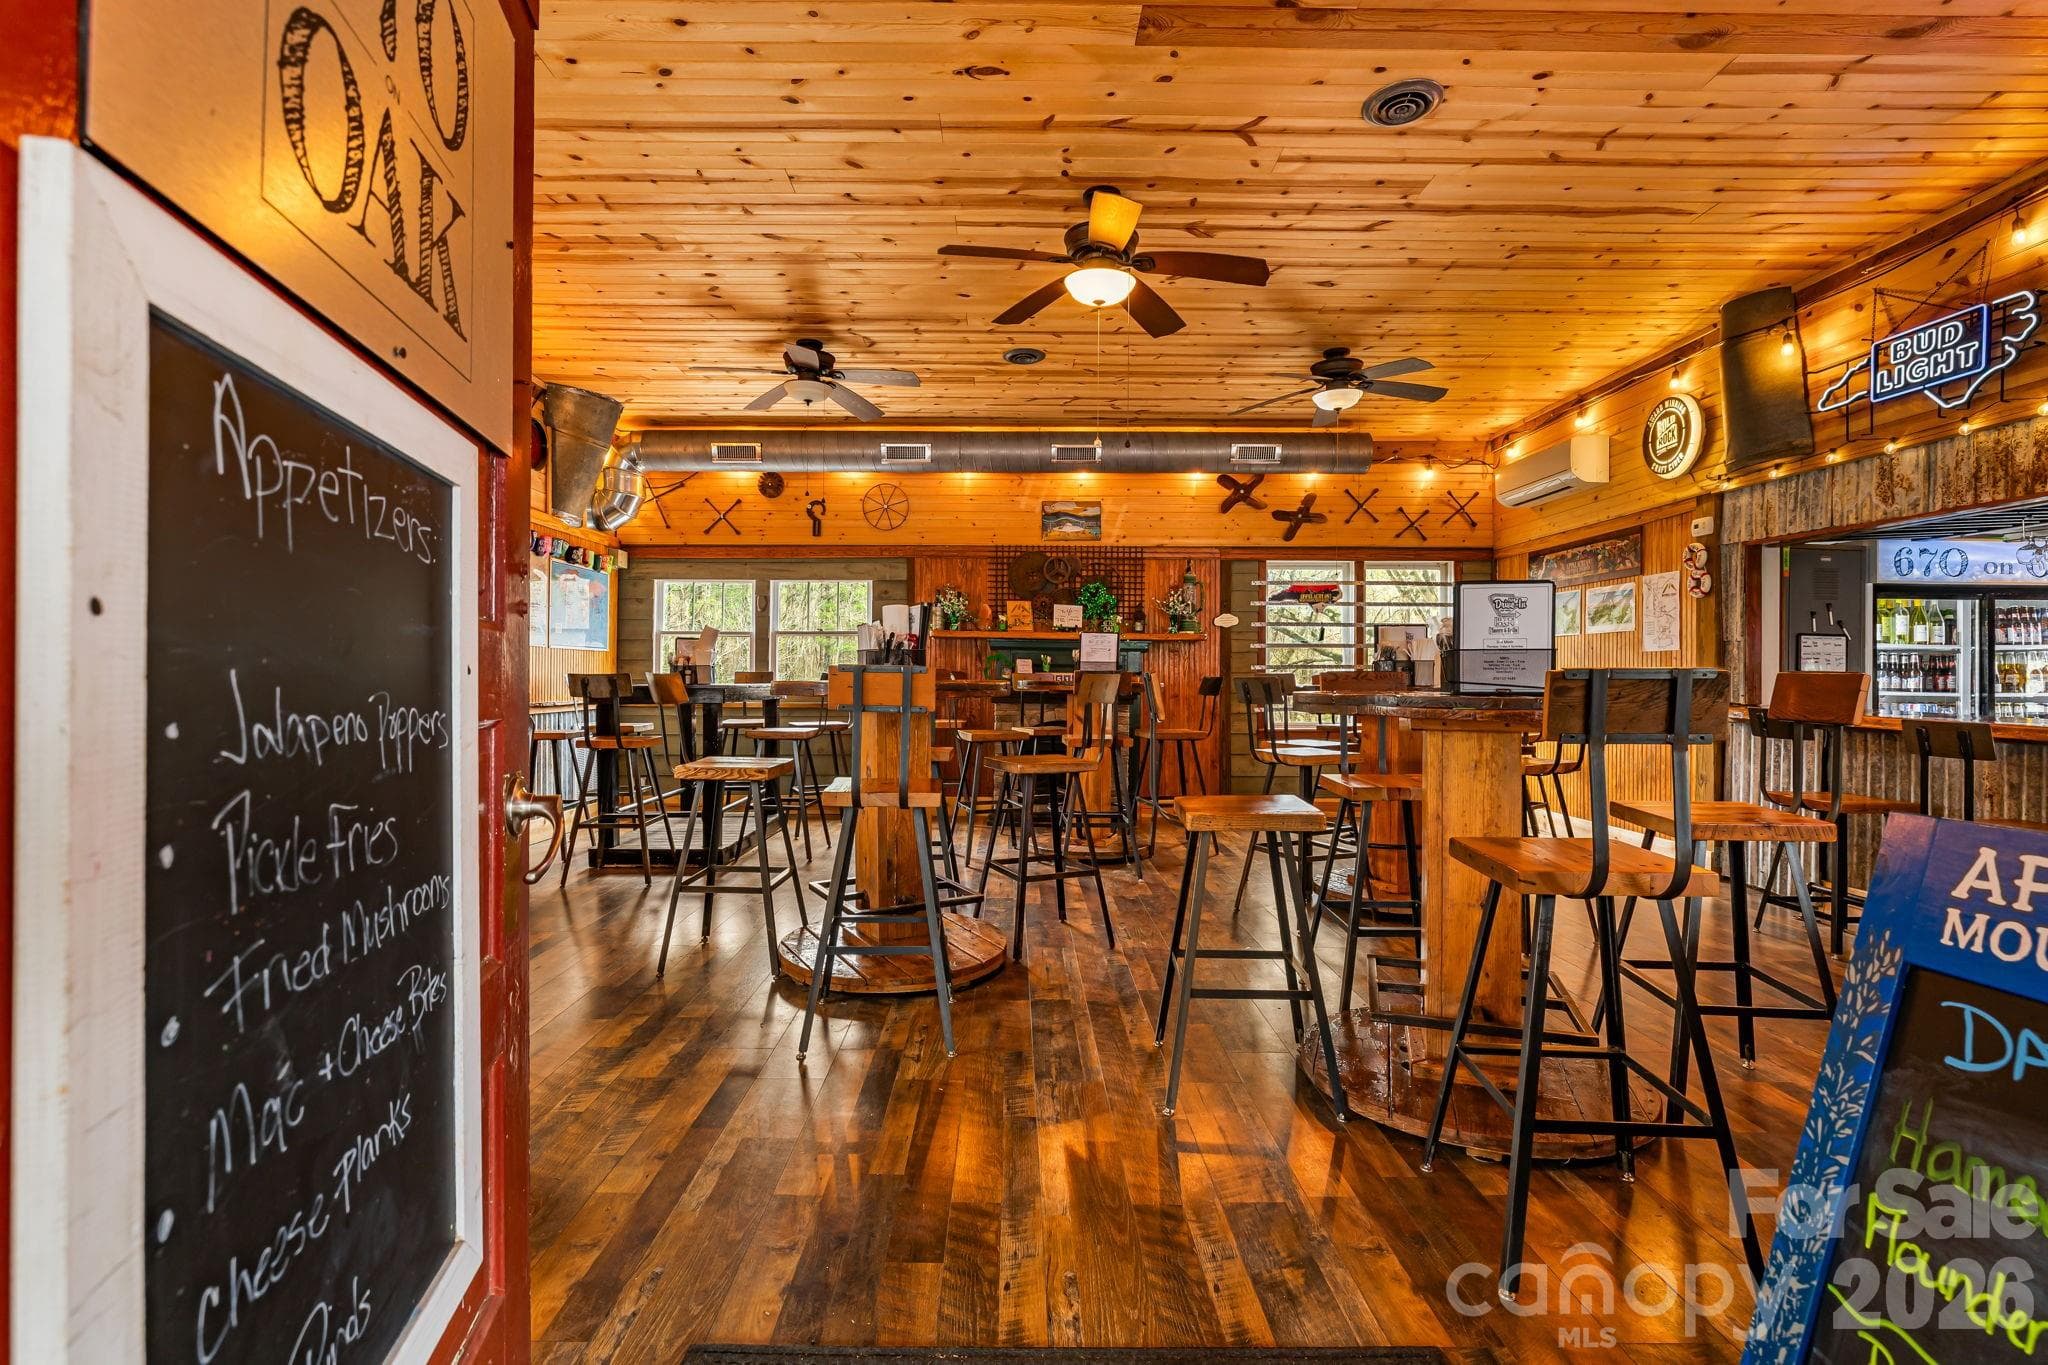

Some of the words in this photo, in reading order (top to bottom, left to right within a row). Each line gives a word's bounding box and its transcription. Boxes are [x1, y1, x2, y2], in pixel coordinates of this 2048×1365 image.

[277, 6, 467, 342] OAK
[1876, 341, 1980, 394] LIGHT
[1890, 320, 1963, 365] BUD
[1658, 425, 1676, 446] ROCK
[1893, 546, 1969, 578] 670
[1983, 560, 2014, 575] on
[213, 668, 368, 767] Jalapeno
[368, 690, 450, 774] Poppers
[211, 789, 323, 915] Pickle
[326, 803, 400, 880] Fries
[204, 922, 332, 1034] Fried
[341, 872, 451, 965] Mushrooms
[207, 1078, 305, 1213] Mac
[397, 964, 447, 1031] Bites
[199, 1193, 330, 1364] Cheese
